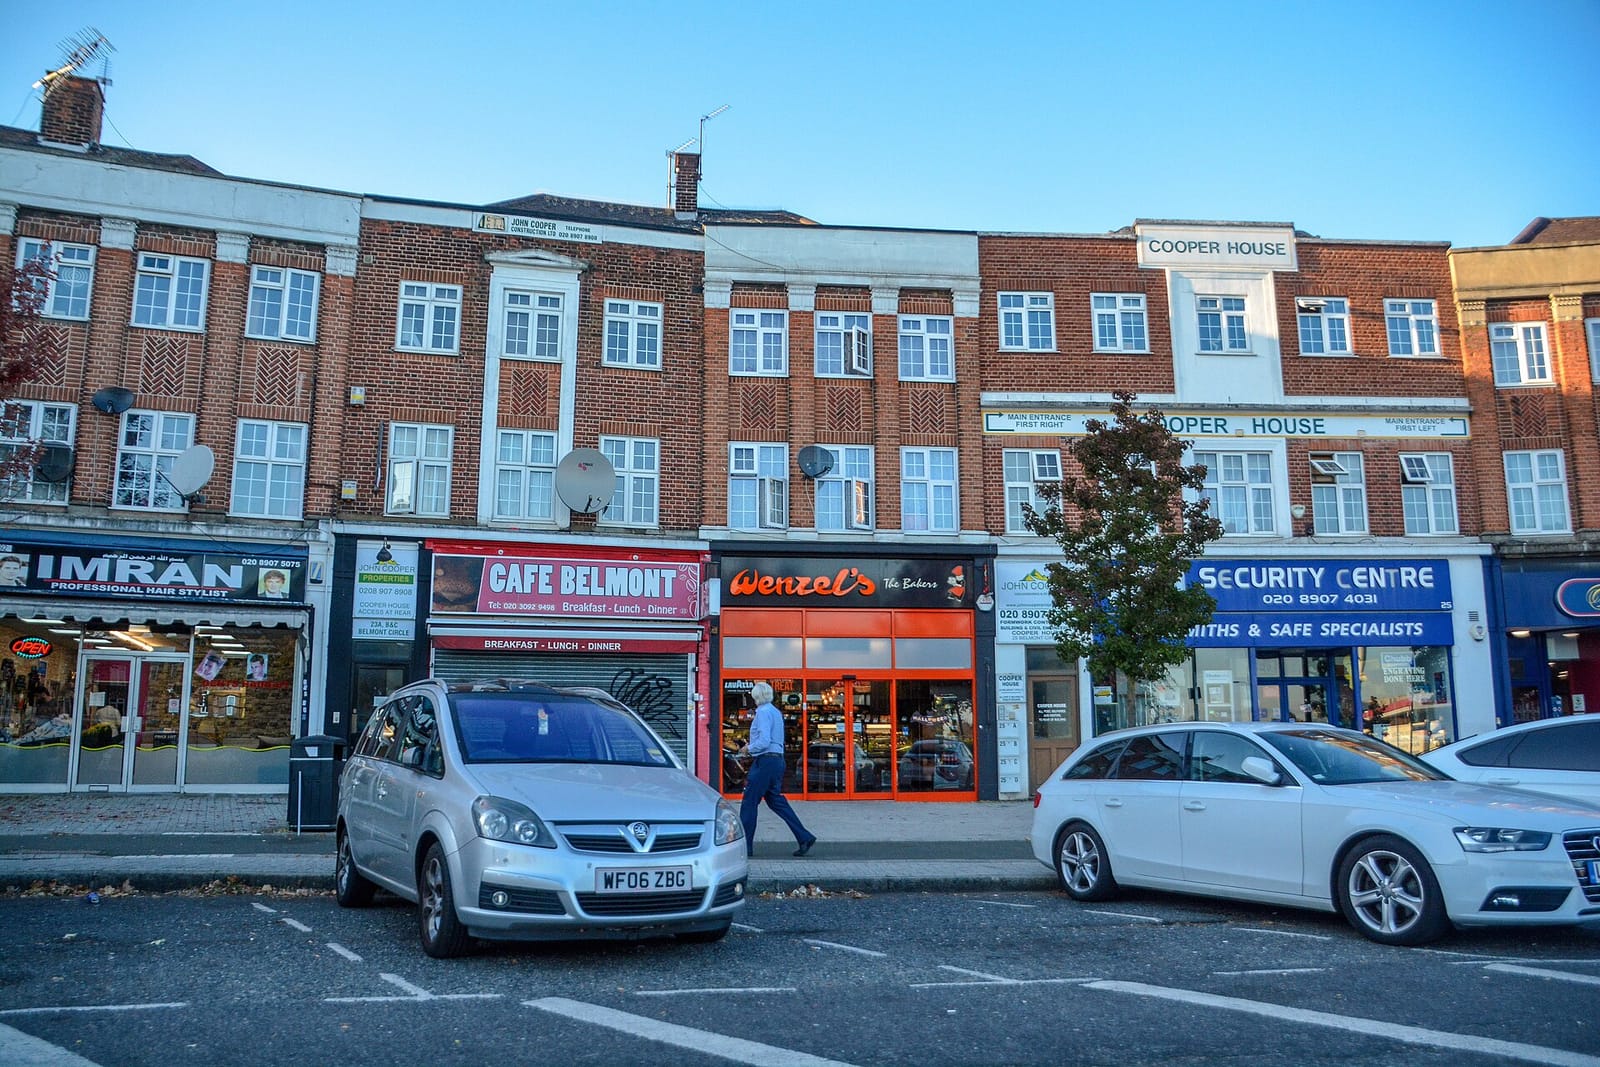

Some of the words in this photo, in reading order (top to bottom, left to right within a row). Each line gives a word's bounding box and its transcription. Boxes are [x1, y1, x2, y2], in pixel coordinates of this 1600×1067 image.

[510, 218, 528, 228] JOHN
[530, 220, 556, 230] COOPER
[510, 226, 546, 236] CONSTRUCTION
[1149, 240, 1220, 254] COOPER
[1227, 241, 1286, 256] HOUSE
[1252, 418, 1326, 434] HOUSE
[37, 554, 244, 588] IMRAN
[362, 574, 410, 582] PROPERTIES
[1199, 566, 1324, 589] SECURITY
[1336, 566, 1434, 589] CENTRE
[489, 562, 554, 594] CAFE
[560, 565, 677, 598] BELMONT
[729, 567, 876, 596] Wenzel's
[884, 578, 900, 588] The
[902, 577, 938, 589] Bakers
[1001, 582, 1028, 590] JOHN
[1030, 582, 1050, 590] COO
[50, 582, 144, 593] PROFESSIONAL
[178, 588, 228, 597] STYLIST
[1262, 594, 1293, 604] 020
[1299, 594, 1338, 604] 8907
[1344, 594, 1378, 604] 4031
[562, 602, 606, 612] Breakfast
[614, 603, 640, 613] Lunch
[648, 604, 678, 614] Dinner
[1000, 610, 1018, 618] 020
[1248, 624, 1260, 637] &
[1270, 624, 1312, 636] SAFE
[1320, 623, 1424, 636] SPECIALISTS
[12, 640, 51, 654] OPEN
[484, 640, 538, 648] BREAKFAST
[548, 642, 578, 650] LUNCH
[604, 872, 649, 889] WF06
[654, 871, 686, 888] ZBG
